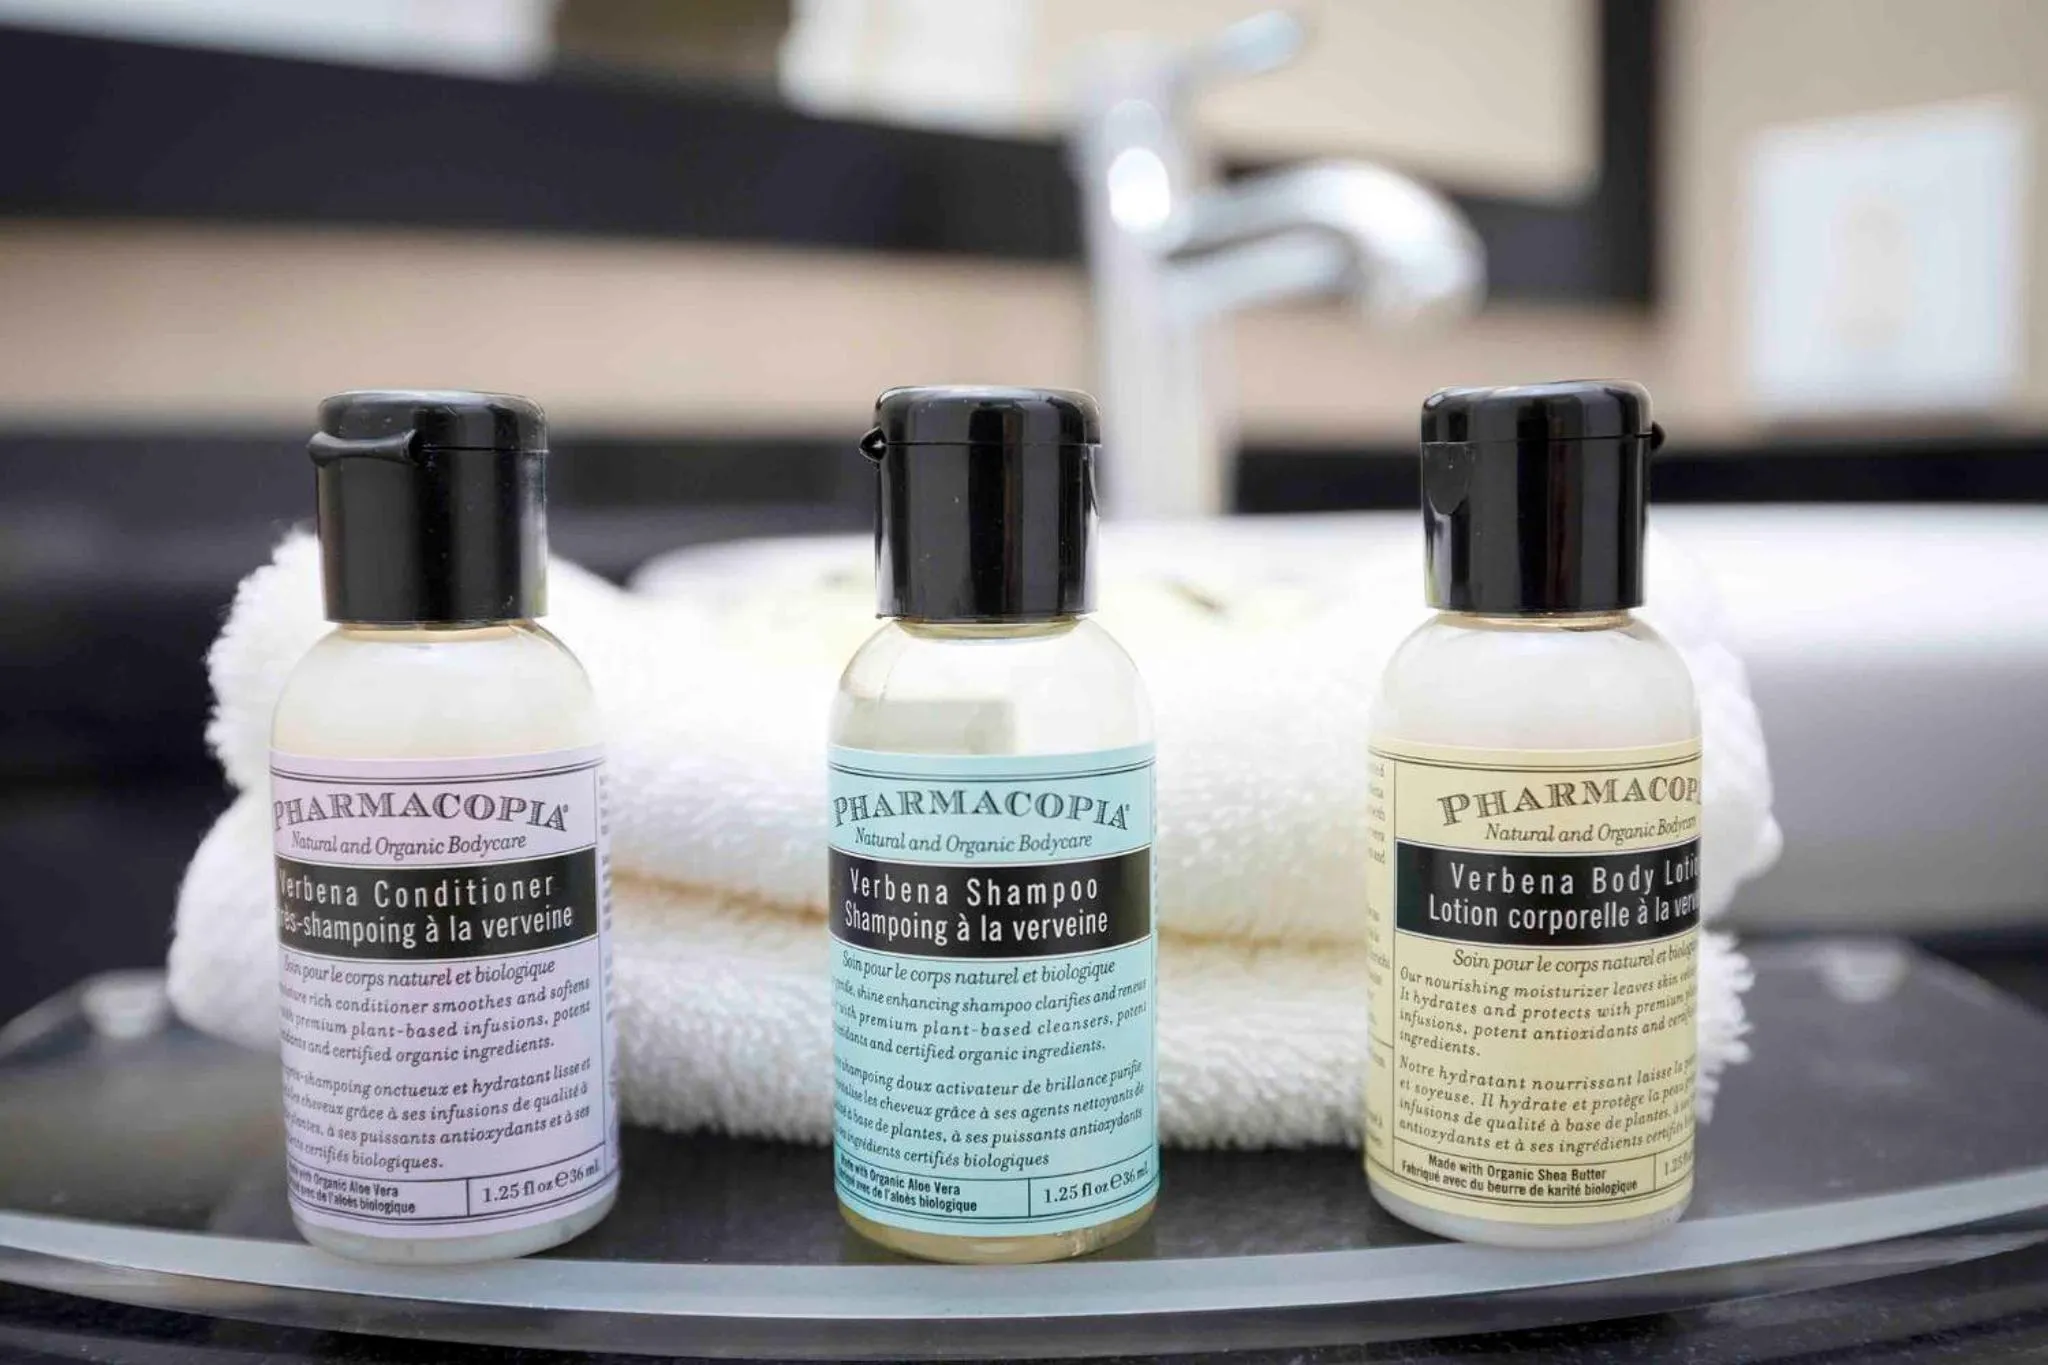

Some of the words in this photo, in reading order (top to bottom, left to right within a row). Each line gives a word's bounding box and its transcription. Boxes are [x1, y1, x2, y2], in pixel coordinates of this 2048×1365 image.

[833, 790, 1128, 830] PHARMACOPIA
[1438, 776, 1700, 826] PHARMACOP
[291, 831, 337, 852] Natural
[340, 838, 371, 854] and
[375, 838, 444, 860] Organic
[448, 834, 526, 858] Bodycare
[855, 827, 906, 849] Natural
[908, 836, 940, 852] and
[946, 835, 1015, 858] Organic
[1019, 833, 1093, 857] Bodycare
[1485, 822, 1555, 842] Natural
[1558, 823, 1593, 842] and
[1598, 823, 1655, 845] Organic
[375, 874, 555, 908] Conditioner
[850, 867, 949, 905] Verbena
[966, 877, 1098, 908] Shampoo
[1450, 861, 1573, 895] Verbena
[1593, 864, 1654, 895] Body
[426, 914, 439, 943] à
[450, 916, 471, 943] la
[482, 906, 573, 938] verveine
[845, 900, 949, 946] Shampoing
[956, 913, 970, 942] à
[981, 915, 1001, 942] la
[1013, 908, 1108, 939] verveine
[1429, 893, 1498, 928] Lotion
[1508, 900, 1629, 935] corporelle
[1637, 898, 1648, 926] à
[1655, 896, 1669, 922] la
[302, 965, 329, 983] pour
[331, 965, 343, 983] le
[345, 971, 384, 991] corps
[388, 968, 452, 987] naturel
[456, 971, 471, 985] et
[475, 960, 555, 984] biologique
[843, 950, 862, 972] Soin
[863, 961, 893, 979] pour
[895, 962, 907, 981] le
[910, 969, 951, 989] corps
[955, 966, 1019, 985] naturel
[1023, 970, 1037, 984] et
[1041, 961, 1115, 984] biologique
[1453, 948, 1490, 967] Soin
[1492, 956, 1534, 975] pour
[1536, 955, 1550, 972] le
[1555, 958, 1599, 978] corps
[1602, 948, 1655, 970] naturel
[1400, 966, 1422, 984] Our
[1425, 975, 1510, 1001] nourishing
[1514, 985, 1609, 999] moisturizer
[1613, 981, 1653, 997] leaves
[1657, 973, 1679, 989] skin
[335, 998, 430, 1014] conditioner
[432, 994, 512, 1013] smoothes
[517, 986, 546, 1005] and
[857, 985, 884, 1004] shine
[886, 993, 960, 1016] enhancing
[962, 997, 1032, 1017] shampoo
[1035, 992, 1091, 1012] clarifies
[1093, 985, 1116, 1003] and
[1413, 992, 1477, 1015] hydrates
[1483, 1004, 1517, 1018] and
[1522, 1007, 1592, 1023] protects
[1597, 1001, 1631, 1016] with
[1635, 993, 1684, 1019] premium
[351, 1021, 457, 1041] plant-based
[552, 1000, 591, 1027] potent
[859, 1011, 918, 1033] premium
[923, 1020, 1031, 1038] plant-based
[1117, 1001, 1147, 1027] potent
[1473, 1024, 1528, 1041] potent
[1533, 1024, 1638, 1041] antioxidants
[1642, 1015, 1665, 1034] and
[308, 1041, 330, 1056] and
[333, 1045, 392, 1065] certified
[396, 1046, 458, 1067] organic
[463, 1036, 555, 1063] ingredients.
[869, 1038, 893, 1053] and
[896, 1043, 955, 1063] certified
[958, 1046, 1019, 1066] organic
[1022, 1038, 1105, 1064] ingredients.
[1400, 1029, 1481, 1057] ingredients.
[374, 1082, 449, 1097] onctueux
[453, 1083, 468, 1095] et
[473, 1071, 551, 1097] hydratant
[554, 1064, 580, 1081] lisse
[897, 1075, 932, 1093] doux
[936, 1081, 1019, 1096] activateur
[1022, 1079, 1041, 1095] de
[1045, 1072, 1108, 1093] brillance
[1400, 1054, 1435, 1077] Notre
[1439, 1065, 1526, 1089] hydratant
[1532, 1074, 1632, 1091] nourrissant
[1637, 1066, 1672, 1085] laisse
[346, 1106, 384, 1121] grâce
[401, 1109, 426, 1121] ses
[430, 1099, 508, 1124] infusions
[512, 1096, 530, 1112] de
[880, 1095, 932, 1117] cheveux
[935, 1106, 976, 1122] grâce
[994, 1108, 1017, 1120] ses
[1021, 1103, 1069, 1123] agents
[1073, 1089, 1134, 1112] nettoyants
[1400, 1098, 1460, 1124] infusions
[1464, 1111, 1482, 1127] de
[1486, 1116, 1545, 1133] qualité
[1566, 1118, 1600, 1132] base
[1605, 1115, 1622, 1130] de
[1499, 1093, 1567, 1114] hydrate
[1572, 1099, 1587, 1111] et
[1592, 1093, 1645, 1115] protège
[1649, 1088, 1659, 1103] la
[360, 1130, 435, 1146] puissants
[440, 1120, 546, 1144] antioxydants
[550, 1115, 562, 1127] et
[875, 1117, 888, 1133] de
[965, 1132, 988, 1144] ses
[992, 1127, 1066, 1148] puissants
[1069, 1108, 1142, 1138] antioxydants
[1399, 1119, 1491, 1149] antioxydants
[1495, 1138, 1509, 1151] et
[1530, 1141, 1554, 1153] ses
[1559, 1134, 1643, 1157] ingrédients
[352, 1149, 443, 1173] biologiques.
[904, 1149, 959, 1169] certifiés
[964, 1153, 1050, 1172] biologiques
[1428, 1153, 1457, 1172] Made
[1459, 1160, 1483, 1176] with
[1487, 1165, 1534, 1181] Organic
[1538, 1169, 1567, 1182] Shea
[1571, 1168, 1607, 1181] Butter
[350, 1181, 371, 1195] Aloe
[373, 1183, 398, 1197] Vera
[482, 1183, 520, 1203] 1.25
[869, 1169, 905, 1188] Organic
[907, 1177, 931, 1192] Aloe
[934, 1181, 960, 1196] Vera
[1044, 1183, 1078, 1203] 1.25
[1402, 1159, 1440, 1182] Fabriqué
[1442, 1174, 1468, 1188] avec
[1470, 1177, 1484, 1191] du
[1487, 1180, 1526, 1195] beurre
[1530, 1183, 1544, 1196] de
[1547, 1183, 1581, 1196] karité
[1585, 1179, 1638, 1196] biologique
[360, 1198, 416, 1215] biologique
[919, 1195, 977, 1213] biologique
